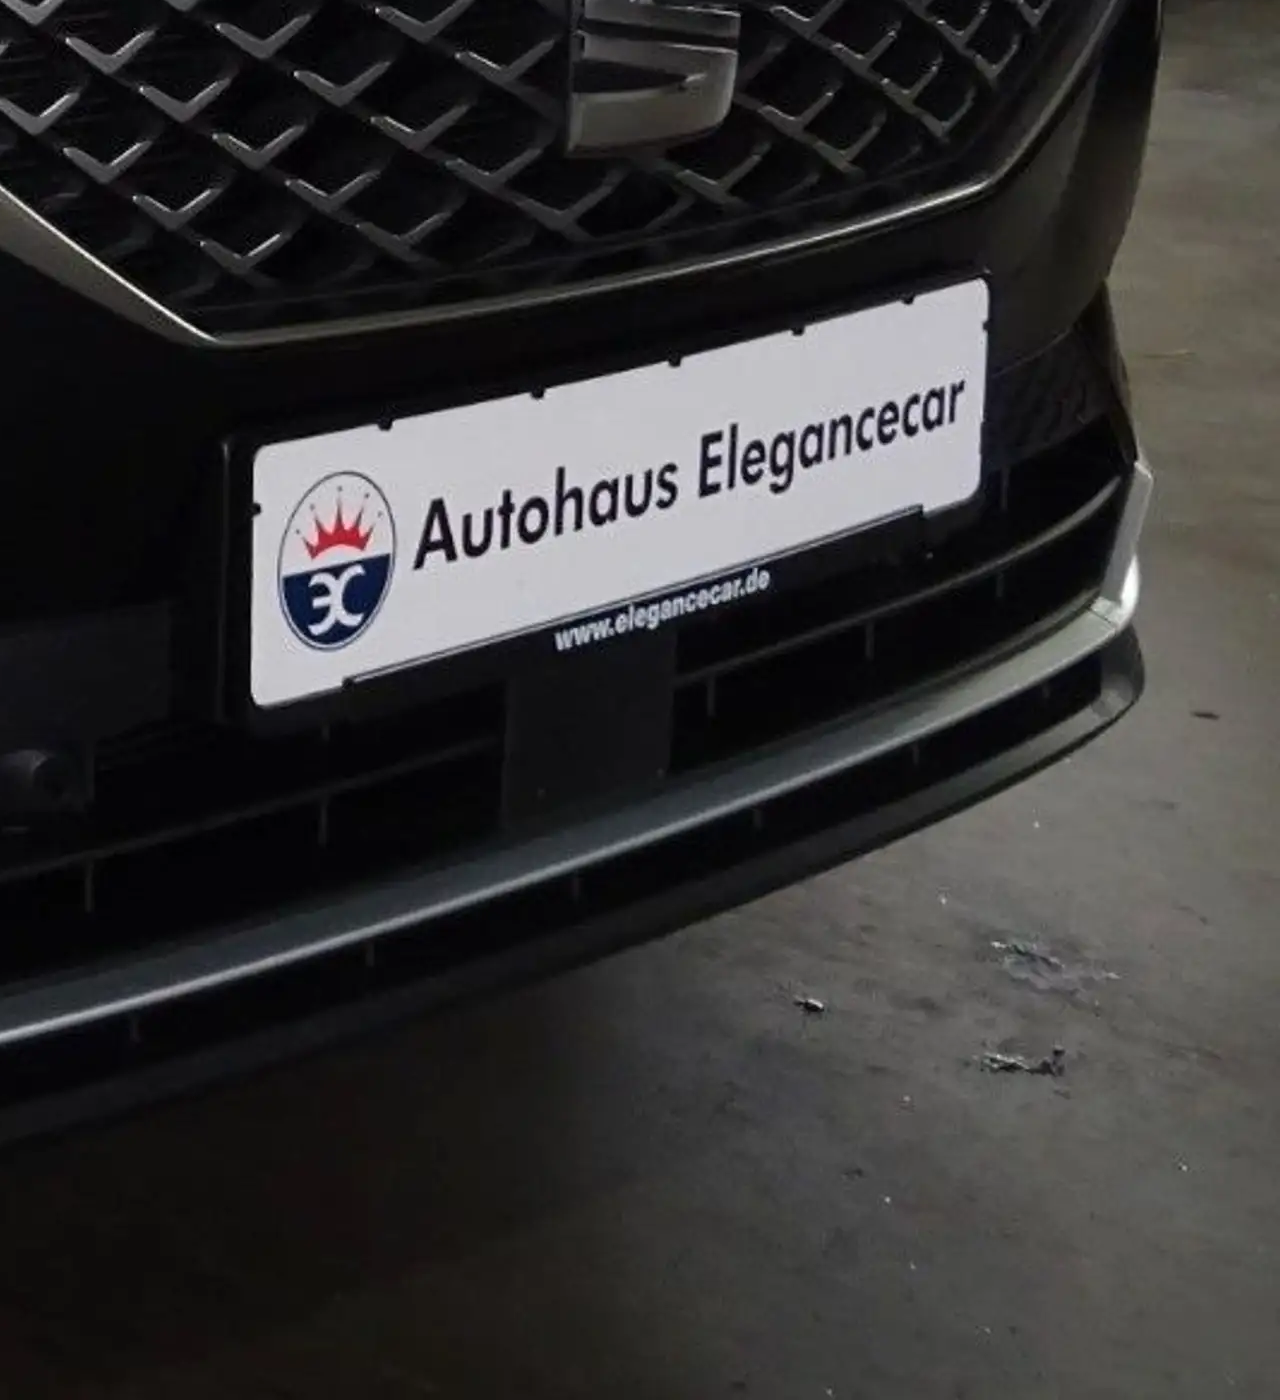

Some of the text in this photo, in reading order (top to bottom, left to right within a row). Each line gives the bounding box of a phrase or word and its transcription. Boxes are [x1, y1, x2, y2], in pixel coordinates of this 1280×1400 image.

[413, 379, 965, 570] Autohaus Elegancecar
[553, 567, 771, 651] www.elegancecar.de
